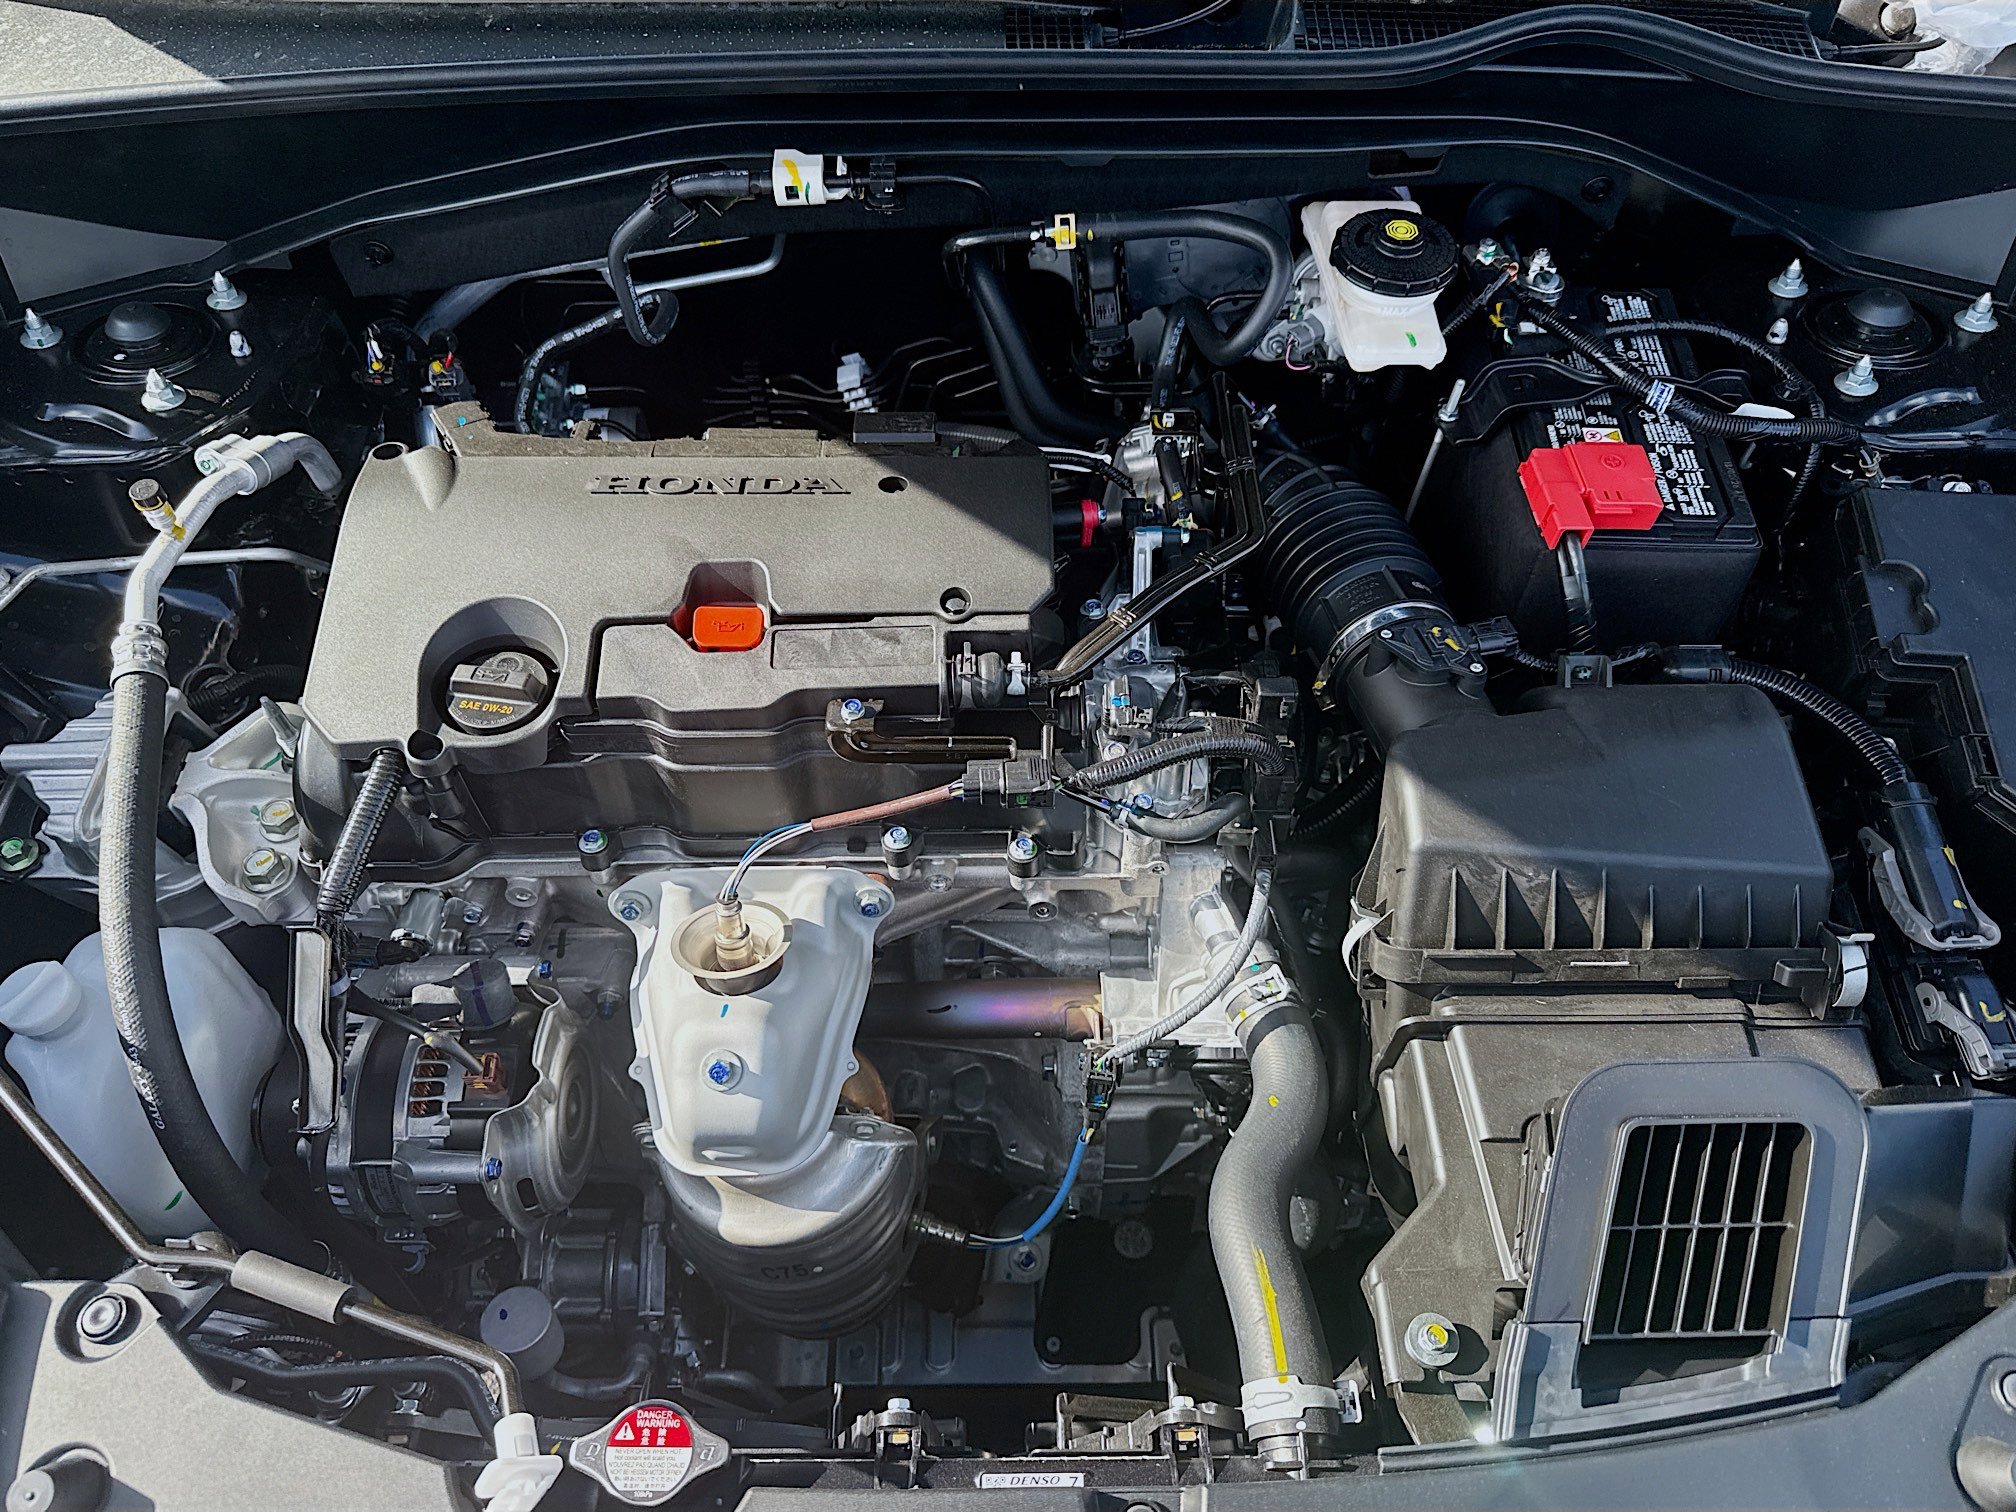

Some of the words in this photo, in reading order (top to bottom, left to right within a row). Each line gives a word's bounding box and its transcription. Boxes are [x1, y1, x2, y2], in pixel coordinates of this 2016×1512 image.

[589, 475, 852, 495] HONDA
[459, 700, 481, 711] SAE
[482, 703, 514, 715] 0W-20
[637, 1410, 674, 1420] DANGER
[636, 1419, 681, 1429] WARNUNG
[1010, 1476, 1060, 1485] DENSO
